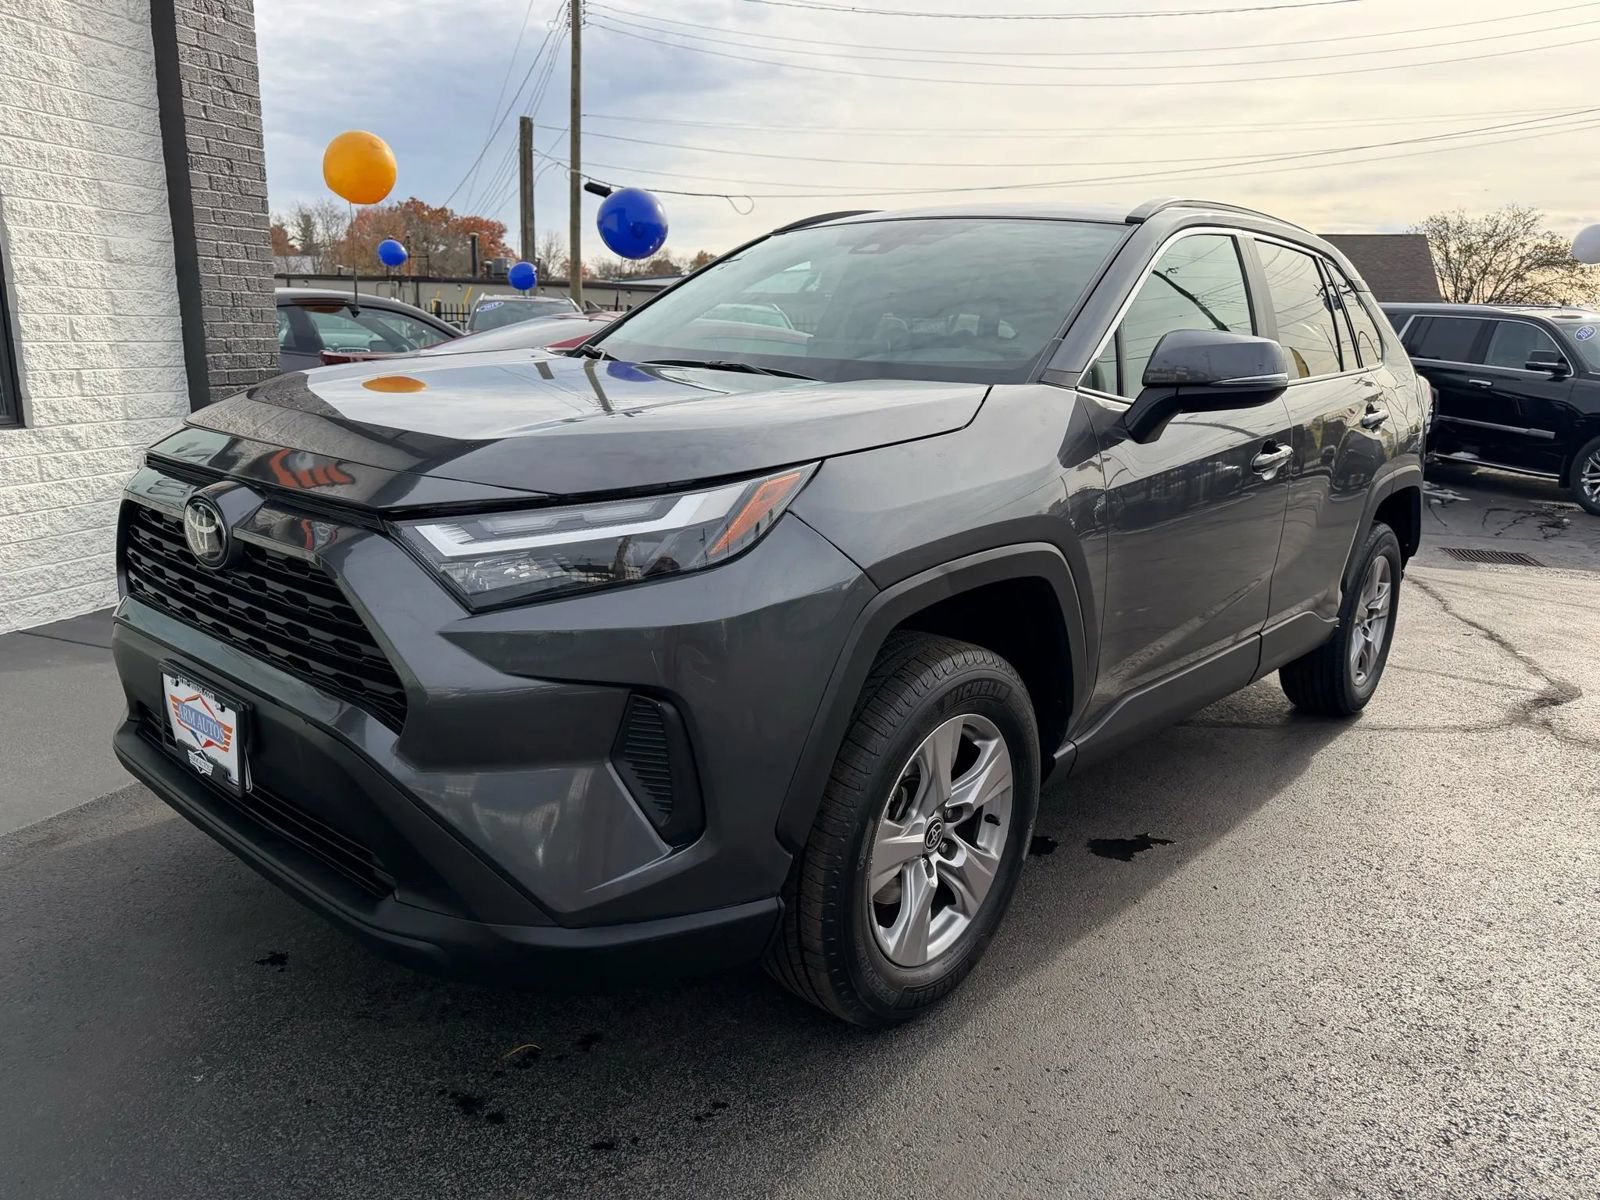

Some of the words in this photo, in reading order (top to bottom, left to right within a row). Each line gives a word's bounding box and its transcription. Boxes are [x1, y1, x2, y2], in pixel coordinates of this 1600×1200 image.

[944, 681, 1009, 706] MICHELIN
[180, 706, 197, 727] ARM
[198, 717, 224, 742] AUTOS
